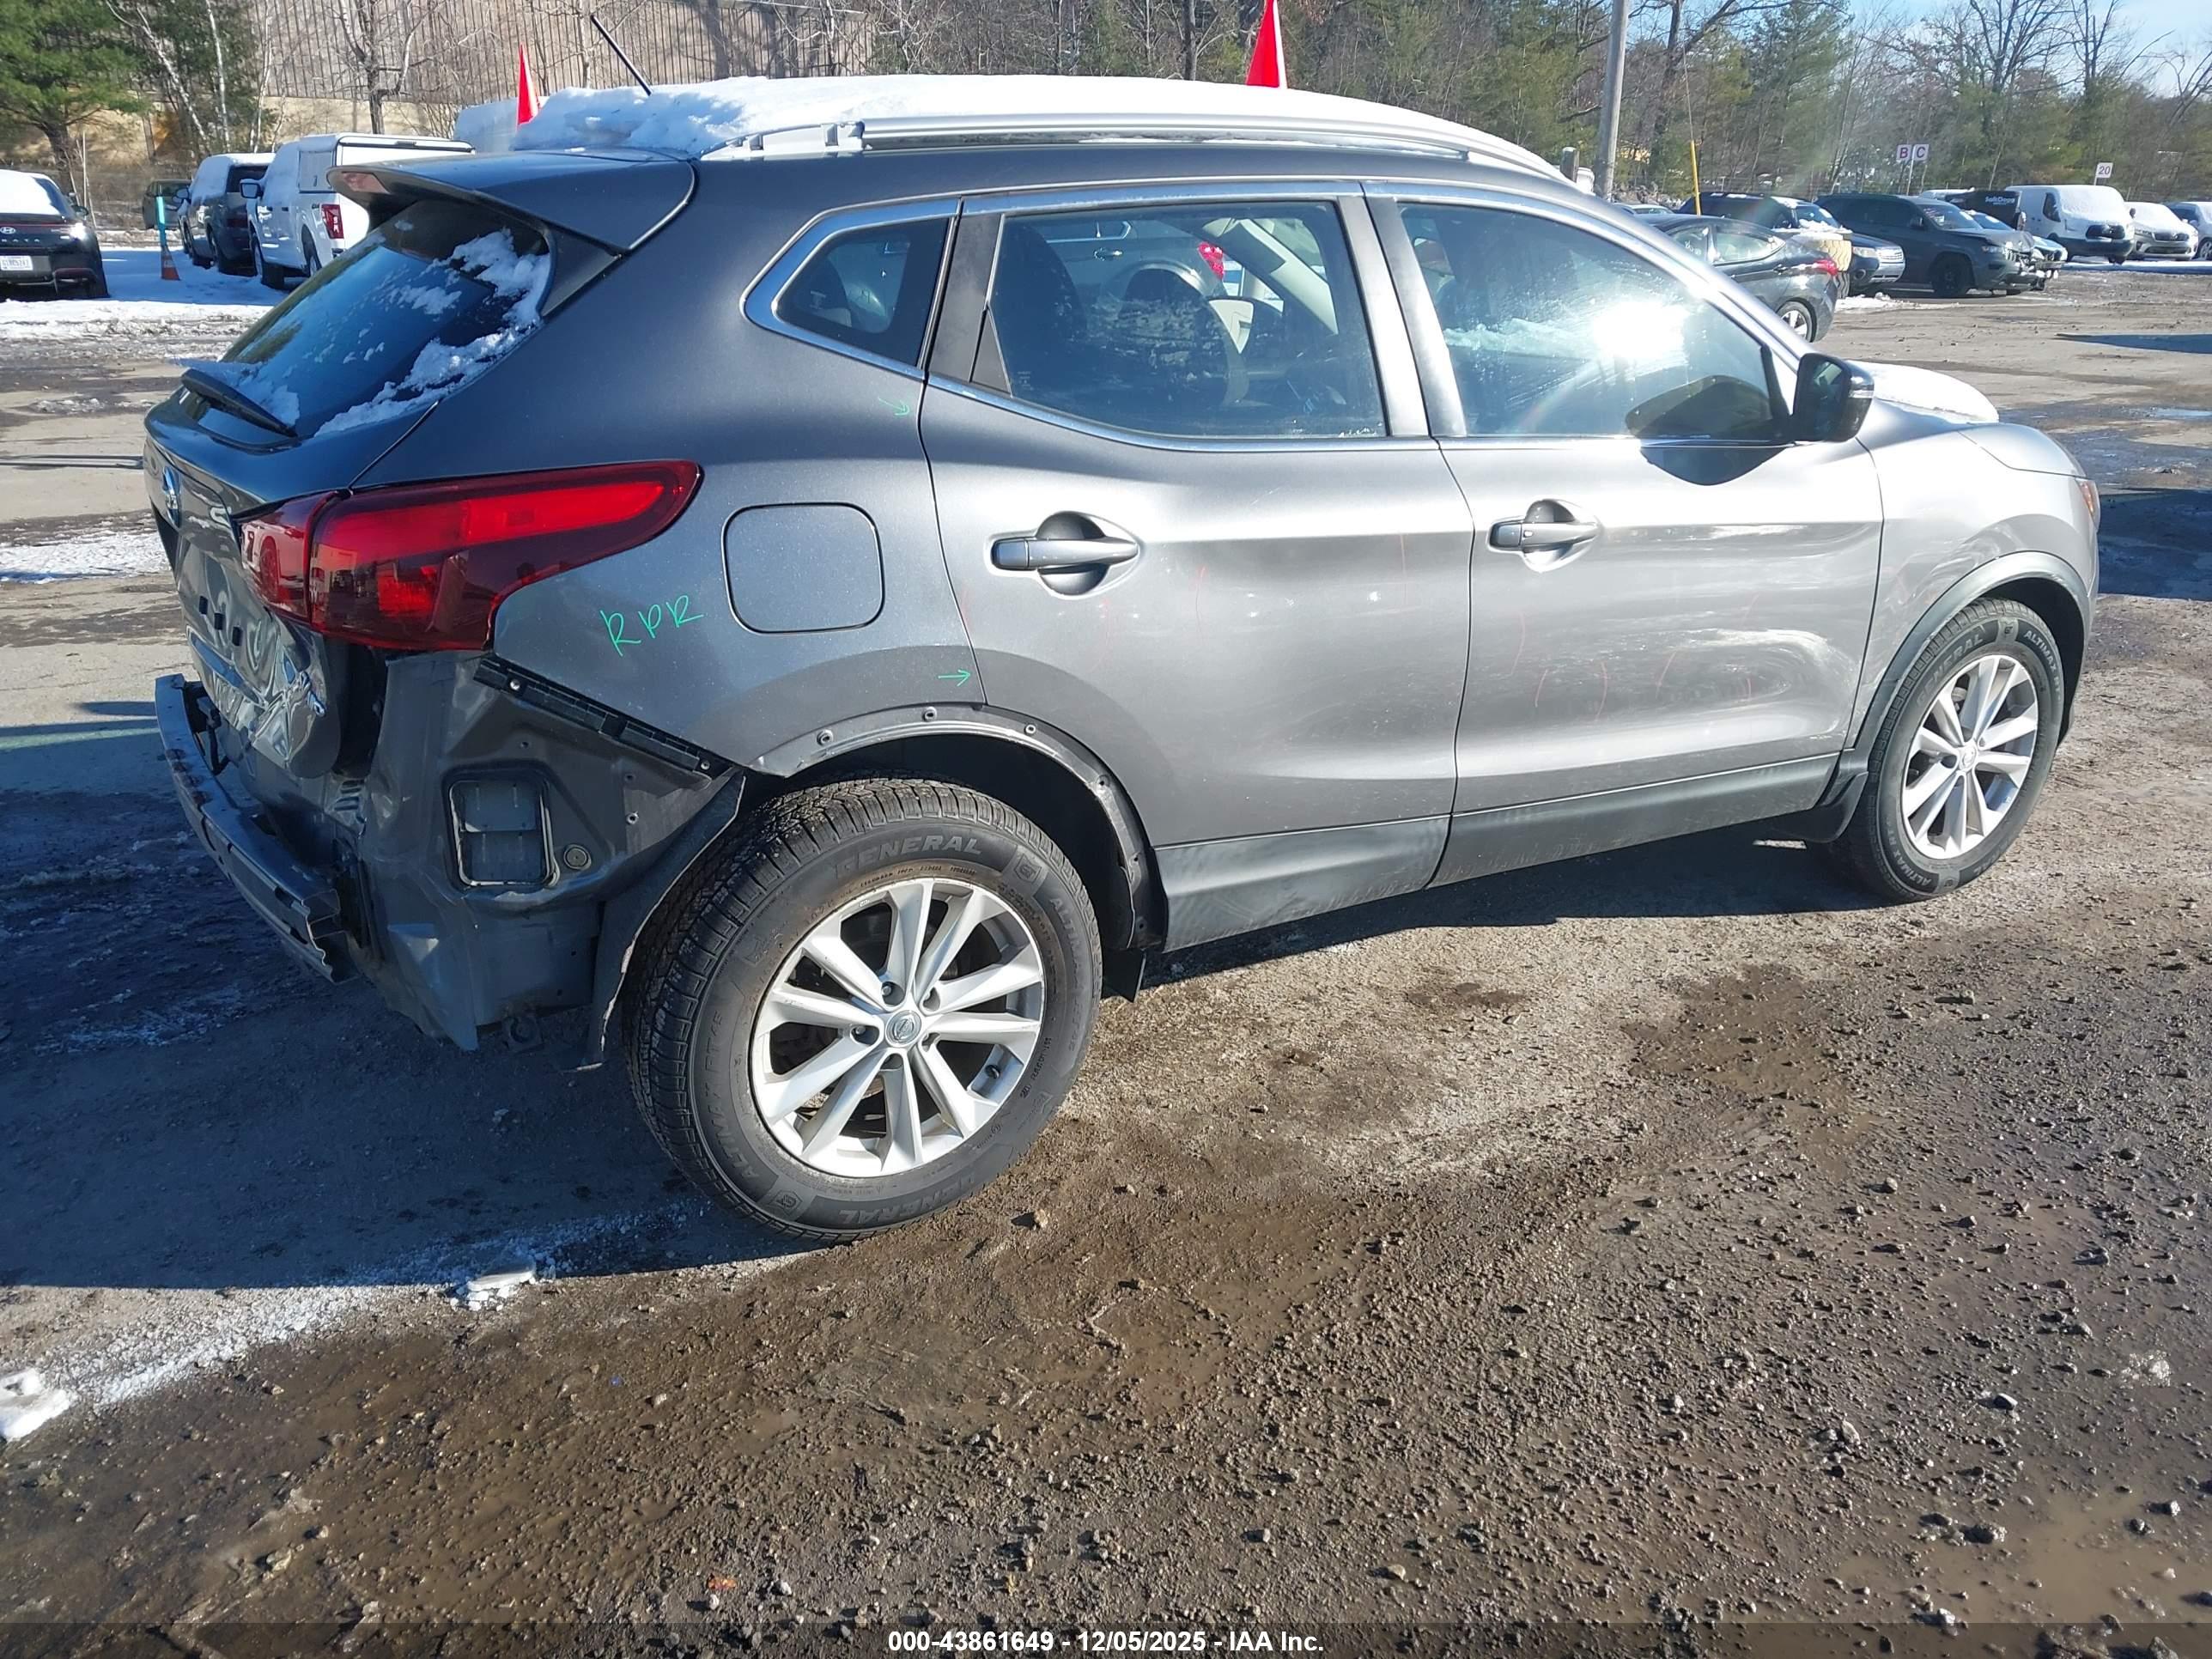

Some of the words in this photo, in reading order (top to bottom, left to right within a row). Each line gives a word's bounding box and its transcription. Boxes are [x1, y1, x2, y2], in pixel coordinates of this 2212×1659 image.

[1899, 147, 1909, 159] B
[1917, 146, 1926, 159] C
[2098, 166, 2111, 175] 20
[599, 594, 704, 657] RPR
[1916, 633, 1984, 708] GENERAL
[2023, 629, 2057, 673] ALTIMAX
[836, 834, 982, 878] GENERAL
[1893, 850, 1933, 886] ALTIMAX
[703, 1082, 760, 1180] ALTIMAX
